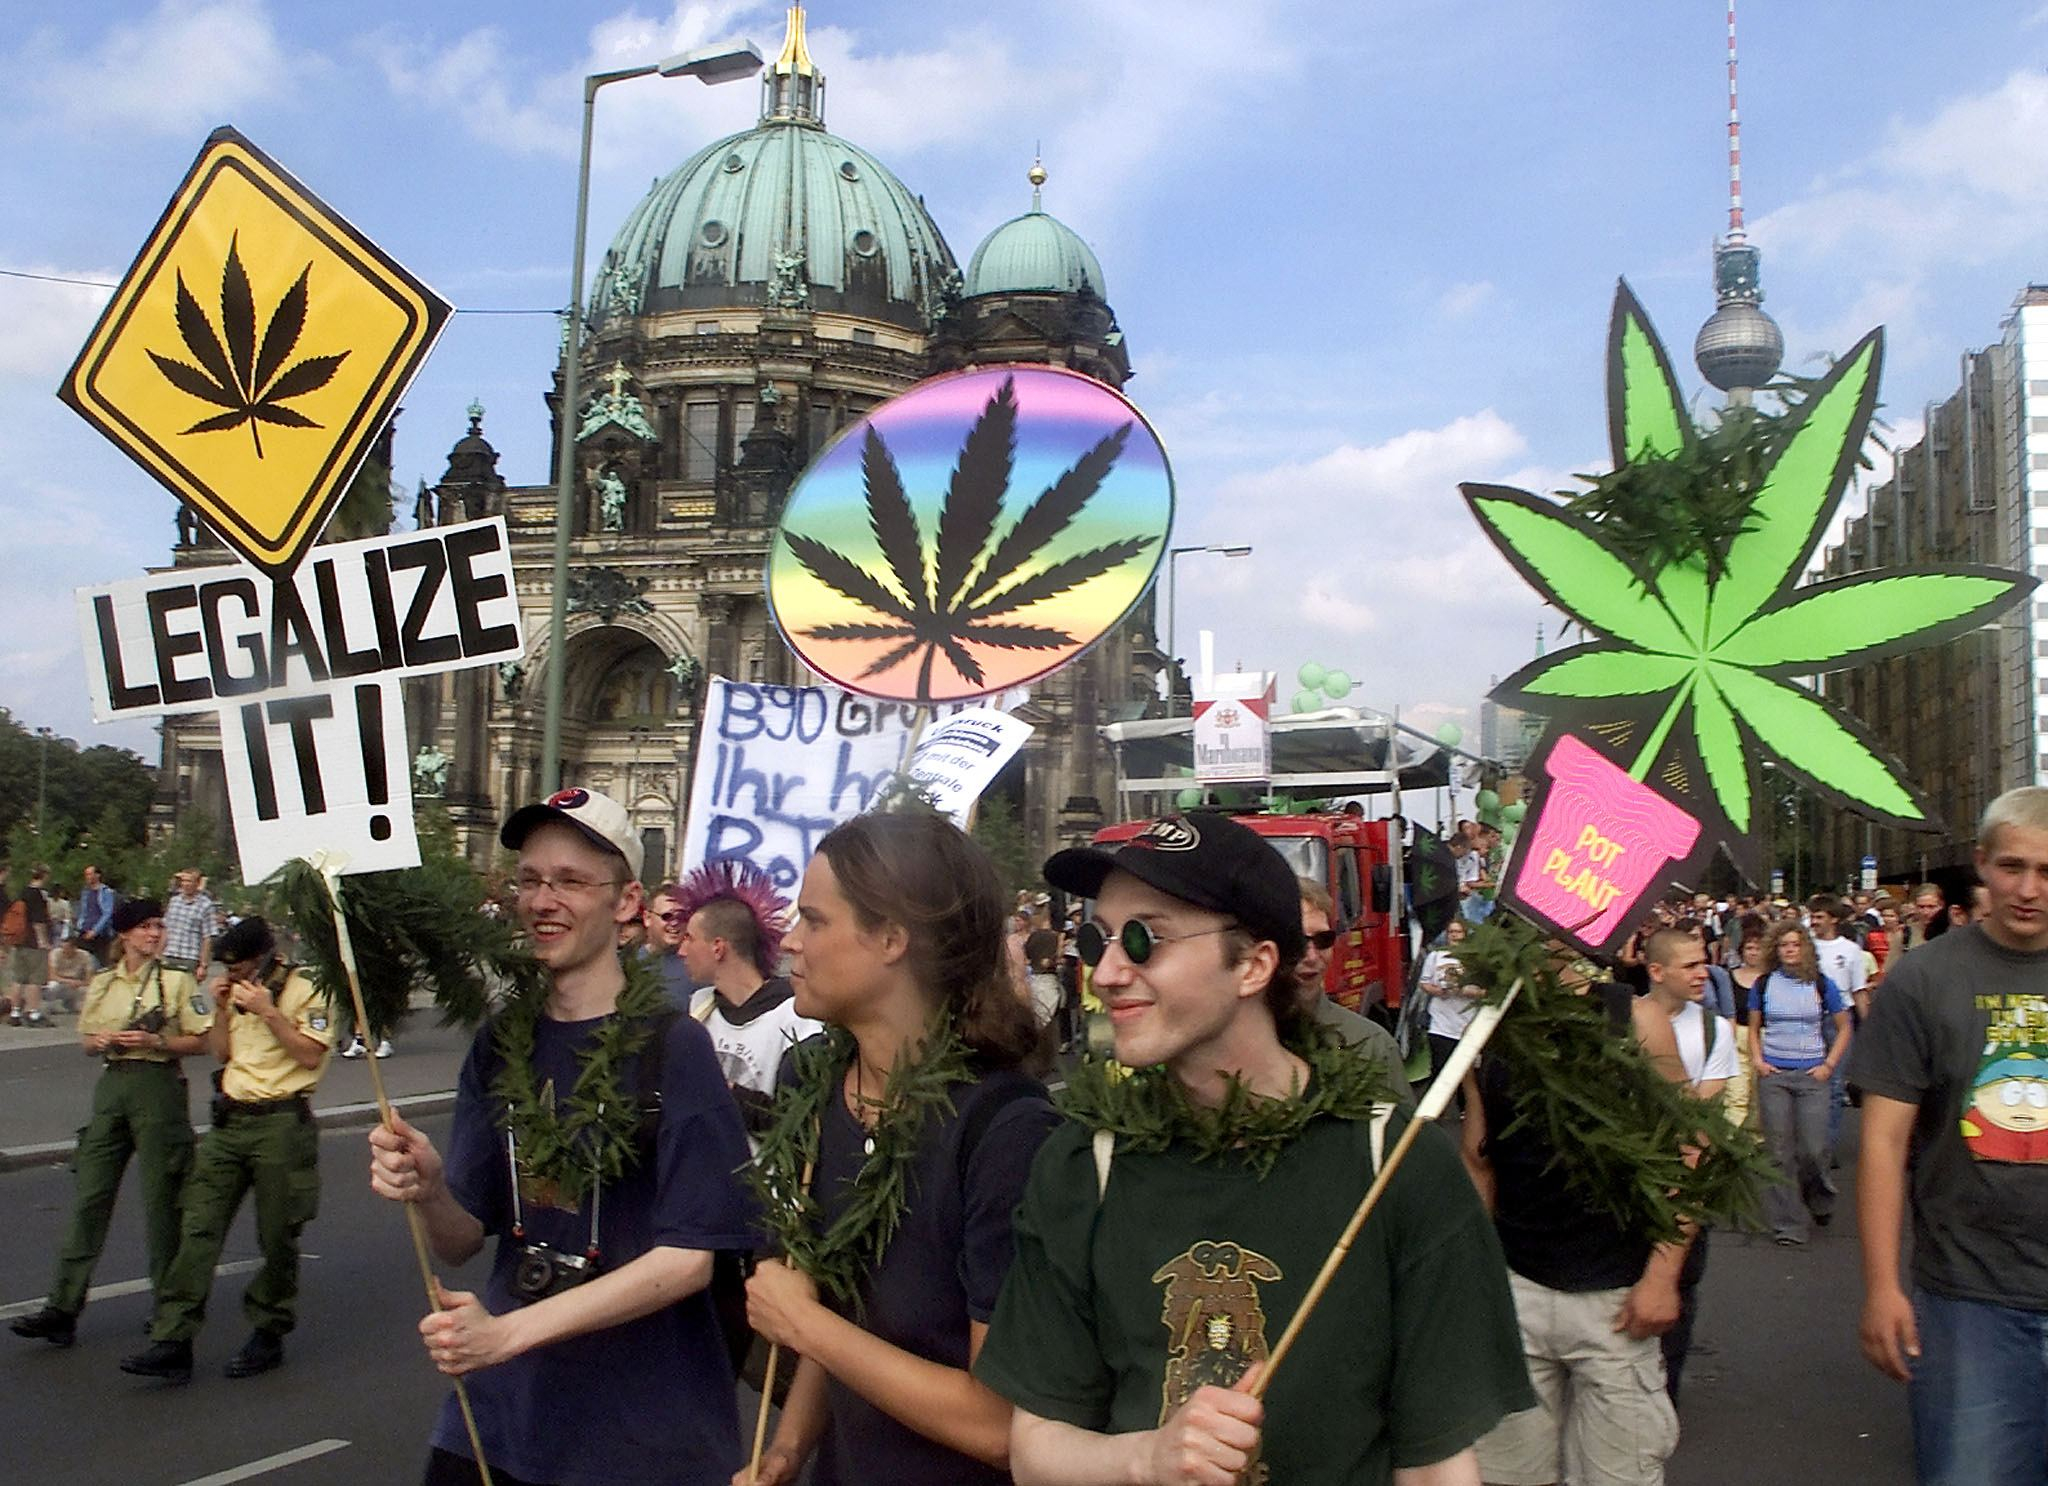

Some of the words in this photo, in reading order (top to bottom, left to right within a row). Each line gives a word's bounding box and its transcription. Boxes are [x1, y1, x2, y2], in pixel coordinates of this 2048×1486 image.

[93, 524, 519, 710] LEGALIZE
[711, 744, 806, 811] Ihr
[1543, 848, 1622, 911] PLANT
[1576, 824, 1625, 870] POT
